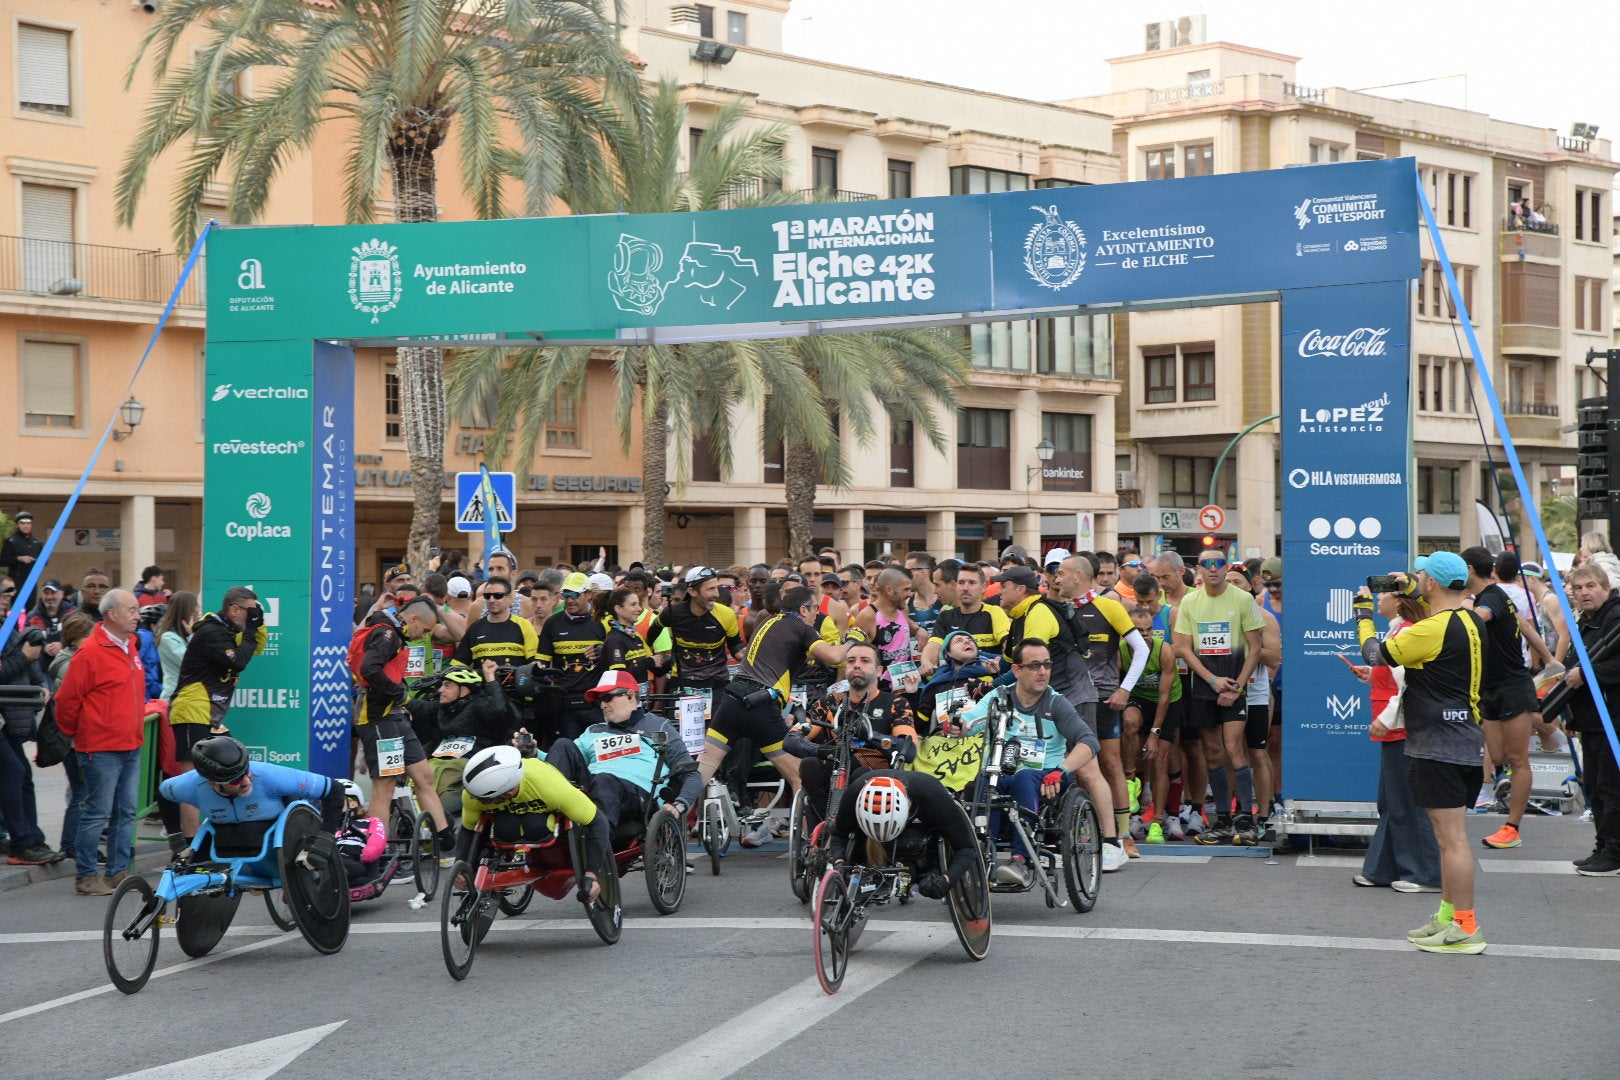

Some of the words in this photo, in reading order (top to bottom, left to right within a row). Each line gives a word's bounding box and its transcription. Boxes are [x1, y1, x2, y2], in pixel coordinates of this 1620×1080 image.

[1312, 200, 1378, 215] COMUNITAT
[1318, 214, 1333, 224] DE
[1335, 209, 1386, 223] L'ESPORT
[771, 220, 805, 252] 1ª
[807, 208, 934, 237] MARATÓN
[1102, 222, 1206, 241] Excelentísimo
[807, 232, 934, 250] INTERNACIONAL
[1095, 237, 1215, 257] AYUNTAMIENTO
[772, 250, 876, 281] Elche
[879, 252, 934, 276] 42K
[1122, 256, 1139, 269] de
[1142, 253, 1189, 268] ELCHE
[413, 260, 527, 281] Ayuntamiento
[426, 281, 447, 295] de
[450, 279, 514, 295] Alicante
[772, 268, 935, 308] Alicante
[229, 296, 274, 304] DIPUTACIÓN
[242, 304, 274, 312] ALICANTE
[1298, 327, 1391, 358] Coca-Cola
[232, 386, 308, 399] vectalia
[1360, 392, 1391, 412] rent
[1300, 407, 1384, 423] LOPEZ
[1299, 424, 1382, 433] Asistencia
[527, 475, 549, 490] DE
[553, 475, 644, 492] SEGUROS
[1311, 471, 1333, 486] HLA
[1334, 472, 1402, 485] VISTAHERMOSA
[320, 405, 335, 633] MONTEMAR
[225, 521, 291, 542] Coplaca
[1310, 542, 1380, 556] Securitas
[337, 550, 346, 602] CLUB
[1201, 636, 1226, 646] 4154
[1303, 630, 1355, 639] ALICANTE
[1442, 710, 1469, 721] UPCT
[601, 735, 633, 749] 3678
[269, 750, 301, 763] Sport
